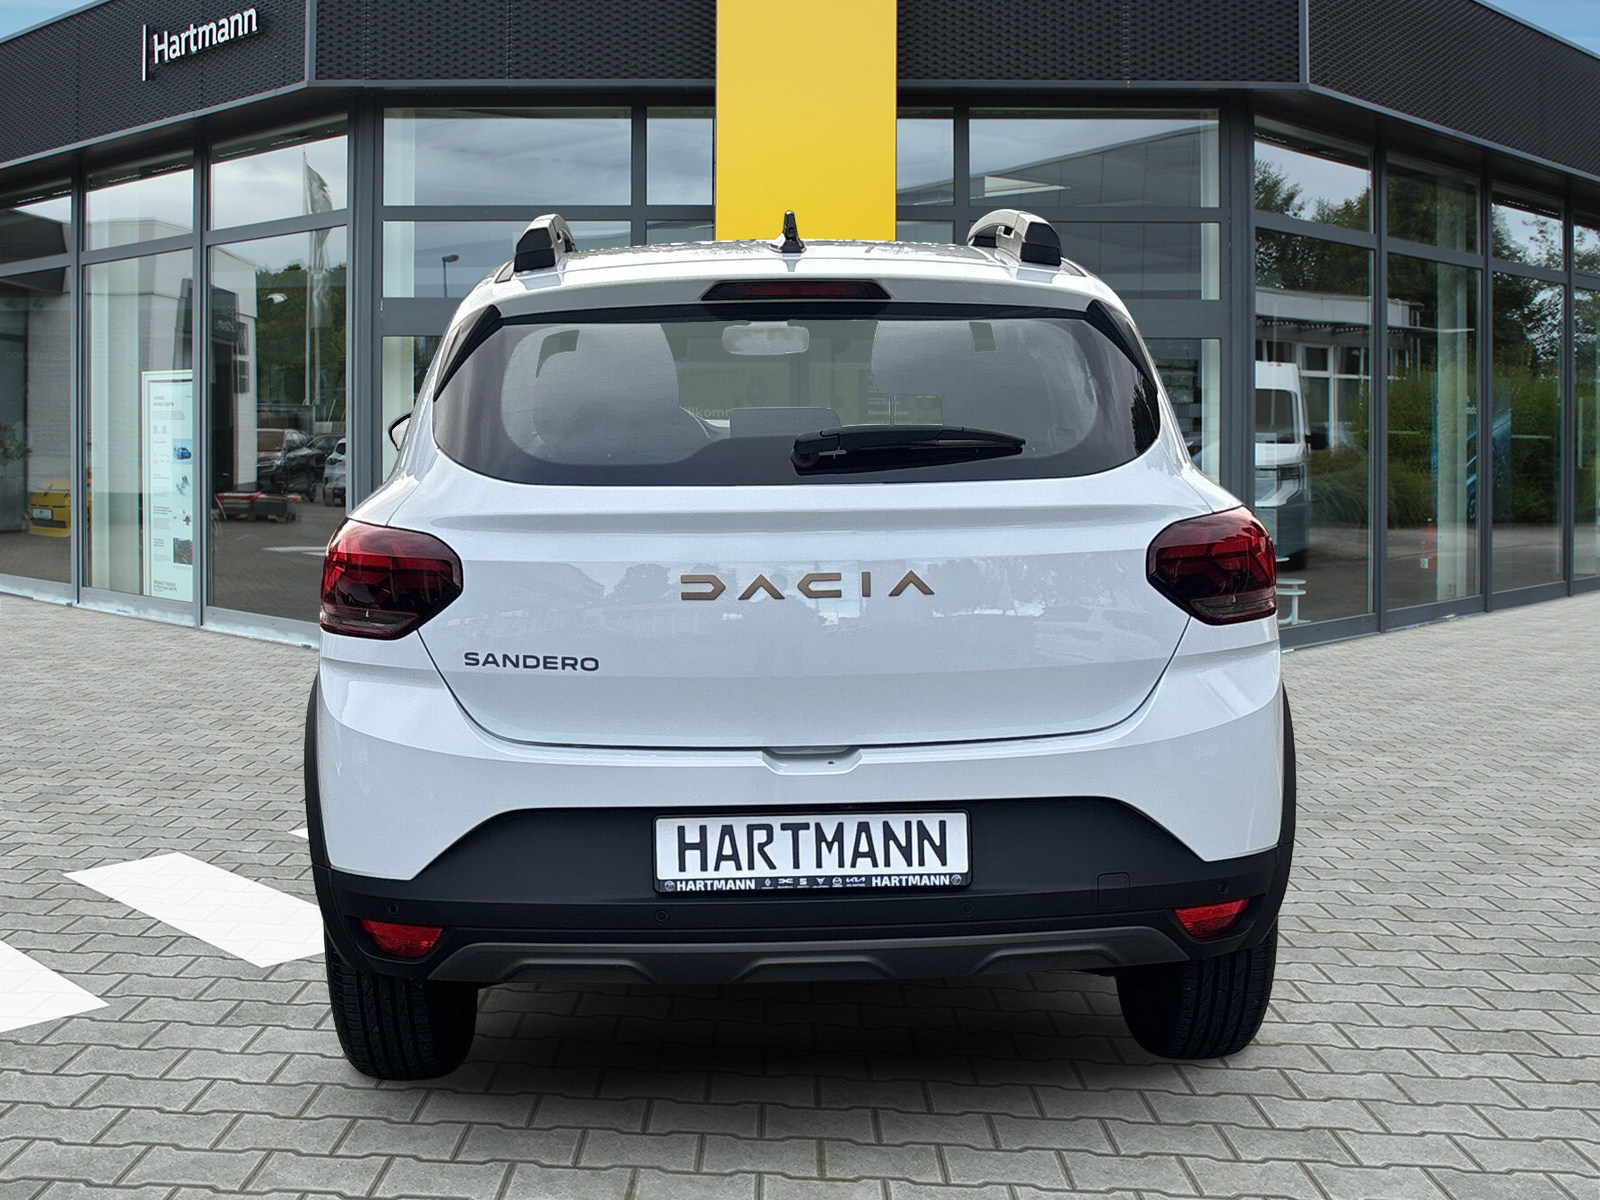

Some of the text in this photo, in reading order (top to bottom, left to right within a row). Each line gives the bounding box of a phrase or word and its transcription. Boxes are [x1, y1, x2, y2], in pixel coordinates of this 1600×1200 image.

[153, 8, 258, 64] Hartmann
[680, 569, 936, 601] DACIA
[463, 651, 600, 672] SANDERO
[677, 820, 947, 872] HARTMANN
[676, 879, 756, 892] HARTMANN
[871, 874, 950, 887] HARTMANN
